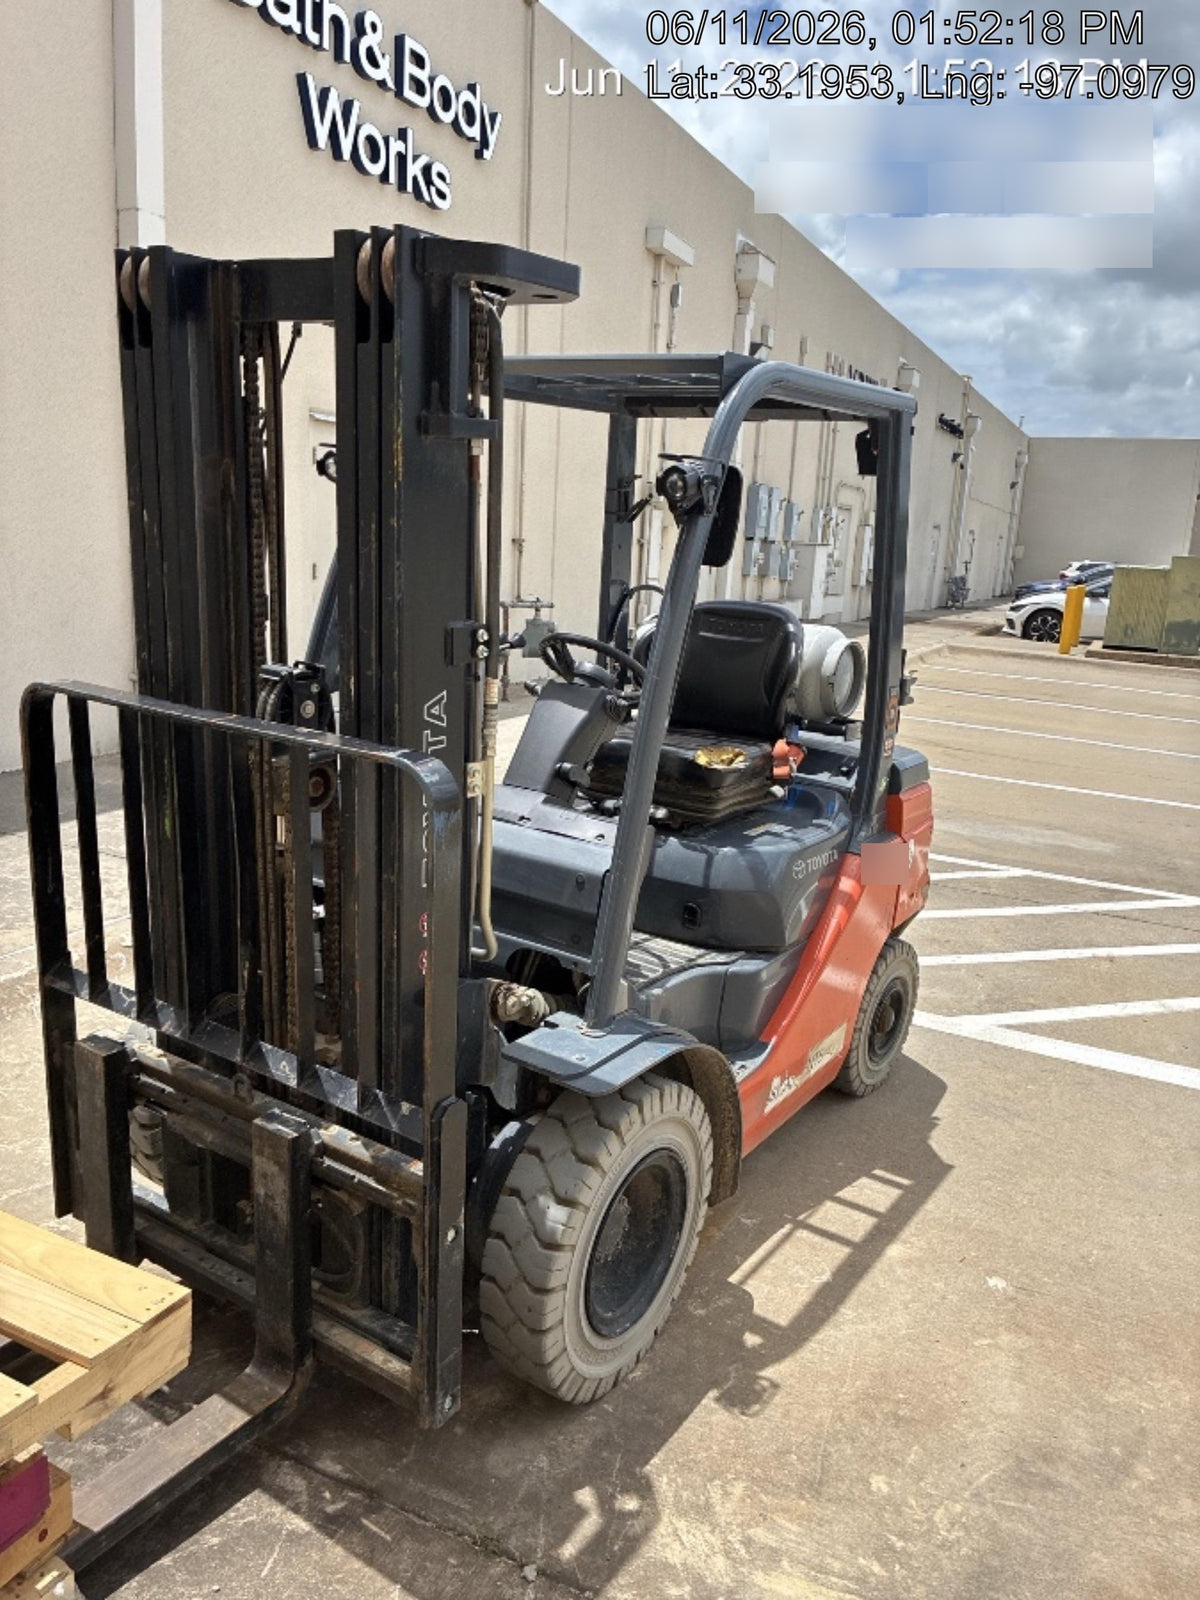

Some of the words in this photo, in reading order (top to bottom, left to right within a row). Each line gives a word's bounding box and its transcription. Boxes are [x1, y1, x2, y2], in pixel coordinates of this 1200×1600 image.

[229, 0, 351, 64] ath
[394, 33, 503, 161] Body
[296, 71, 452, 211] Works
